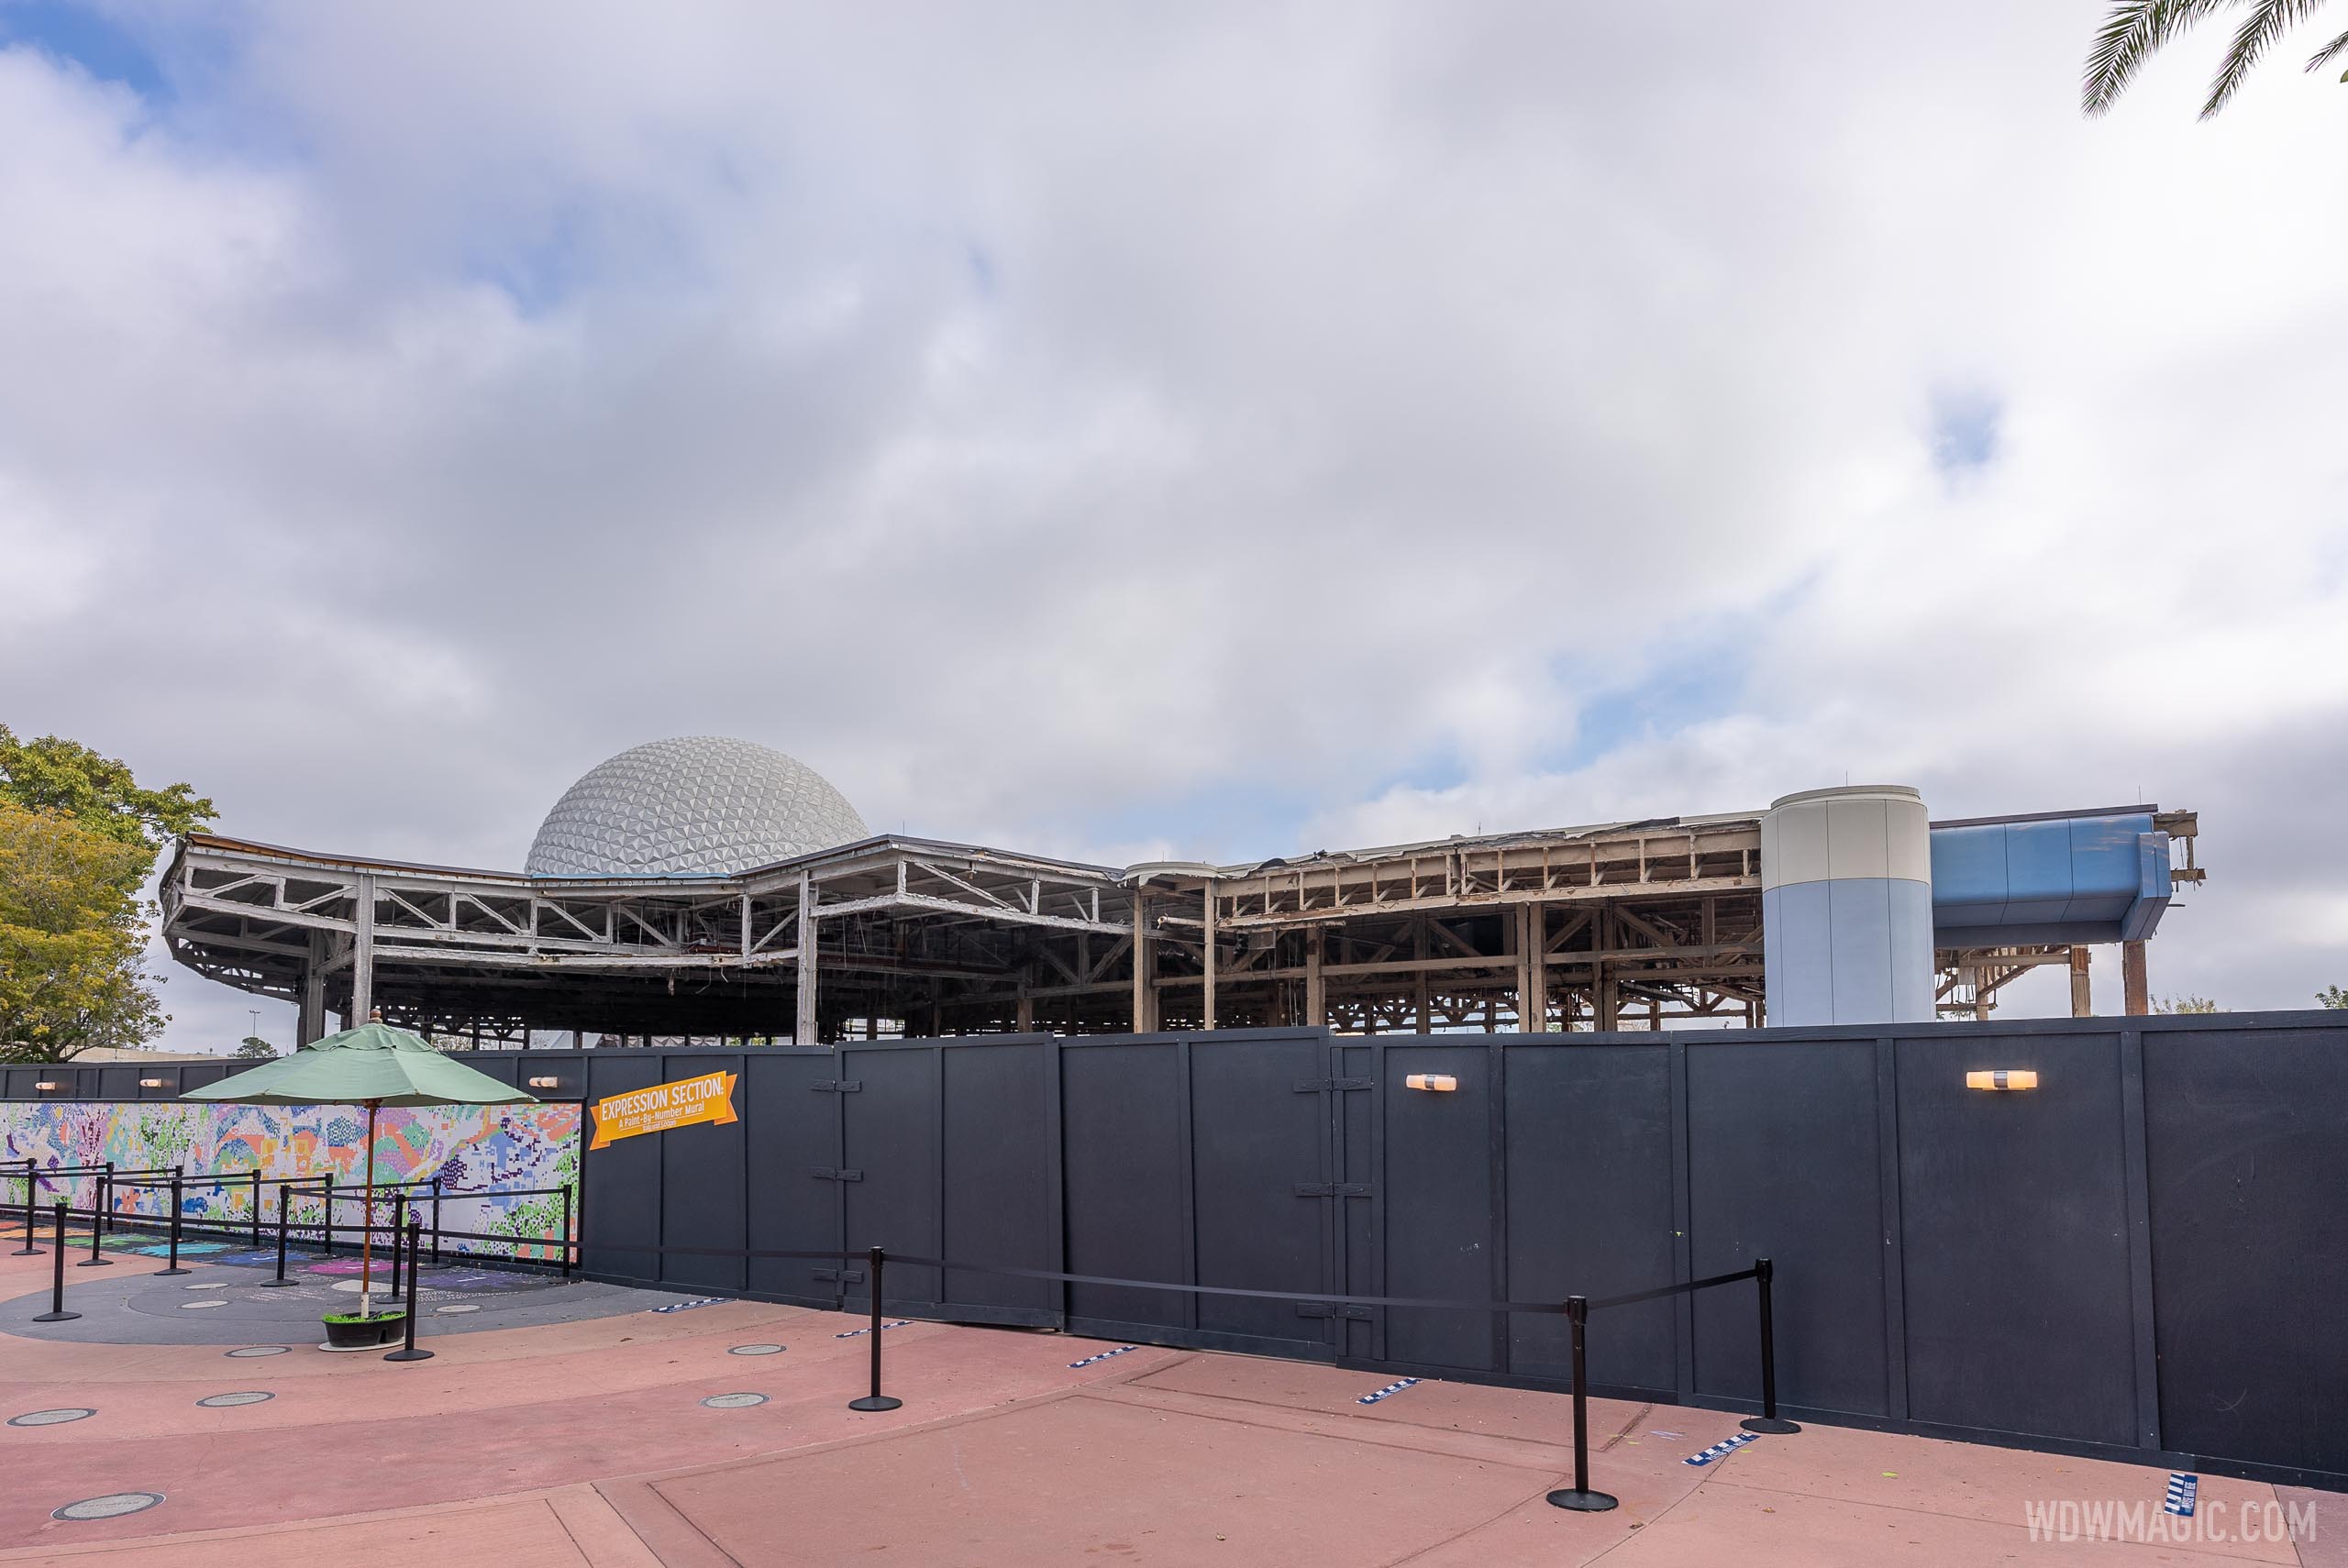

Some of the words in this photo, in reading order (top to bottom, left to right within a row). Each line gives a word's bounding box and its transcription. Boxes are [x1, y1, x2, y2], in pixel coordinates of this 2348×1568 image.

[602, 1088, 669, 1121] EXPRESSION
[671, 1076, 725, 1106] SECTION:
[618, 1119, 624, 1130] A
[625, 1107, 683, 1126] Paint-By-Number
[685, 1099, 704, 1115] Mural
